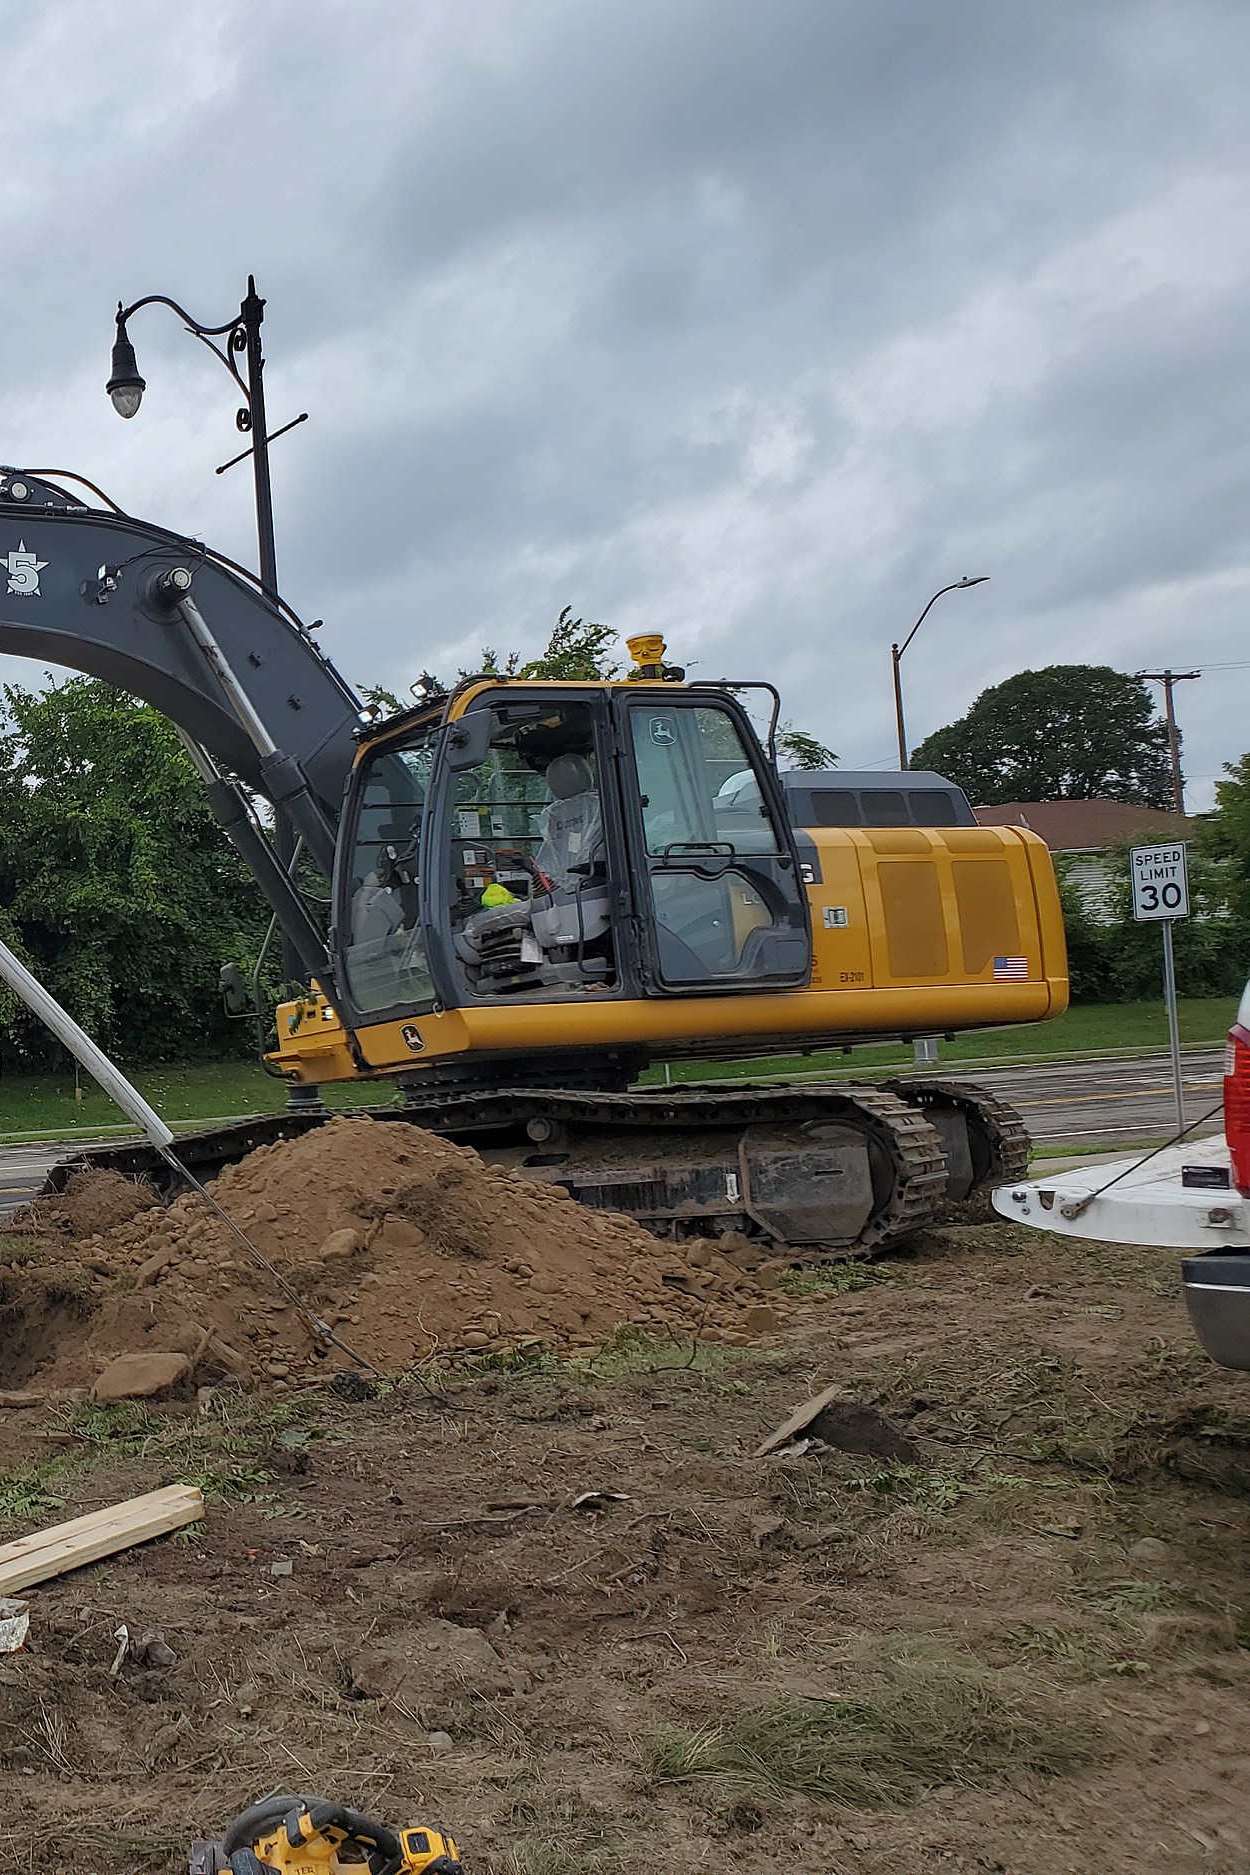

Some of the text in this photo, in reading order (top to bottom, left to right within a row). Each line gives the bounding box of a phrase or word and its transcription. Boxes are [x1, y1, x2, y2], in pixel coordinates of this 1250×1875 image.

[7, 551, 39, 592] 5
[1136, 851, 1181, 866] SPEED
[1141, 866, 1177, 881] LIMIT
[1141, 882, 1181, 911] 30
